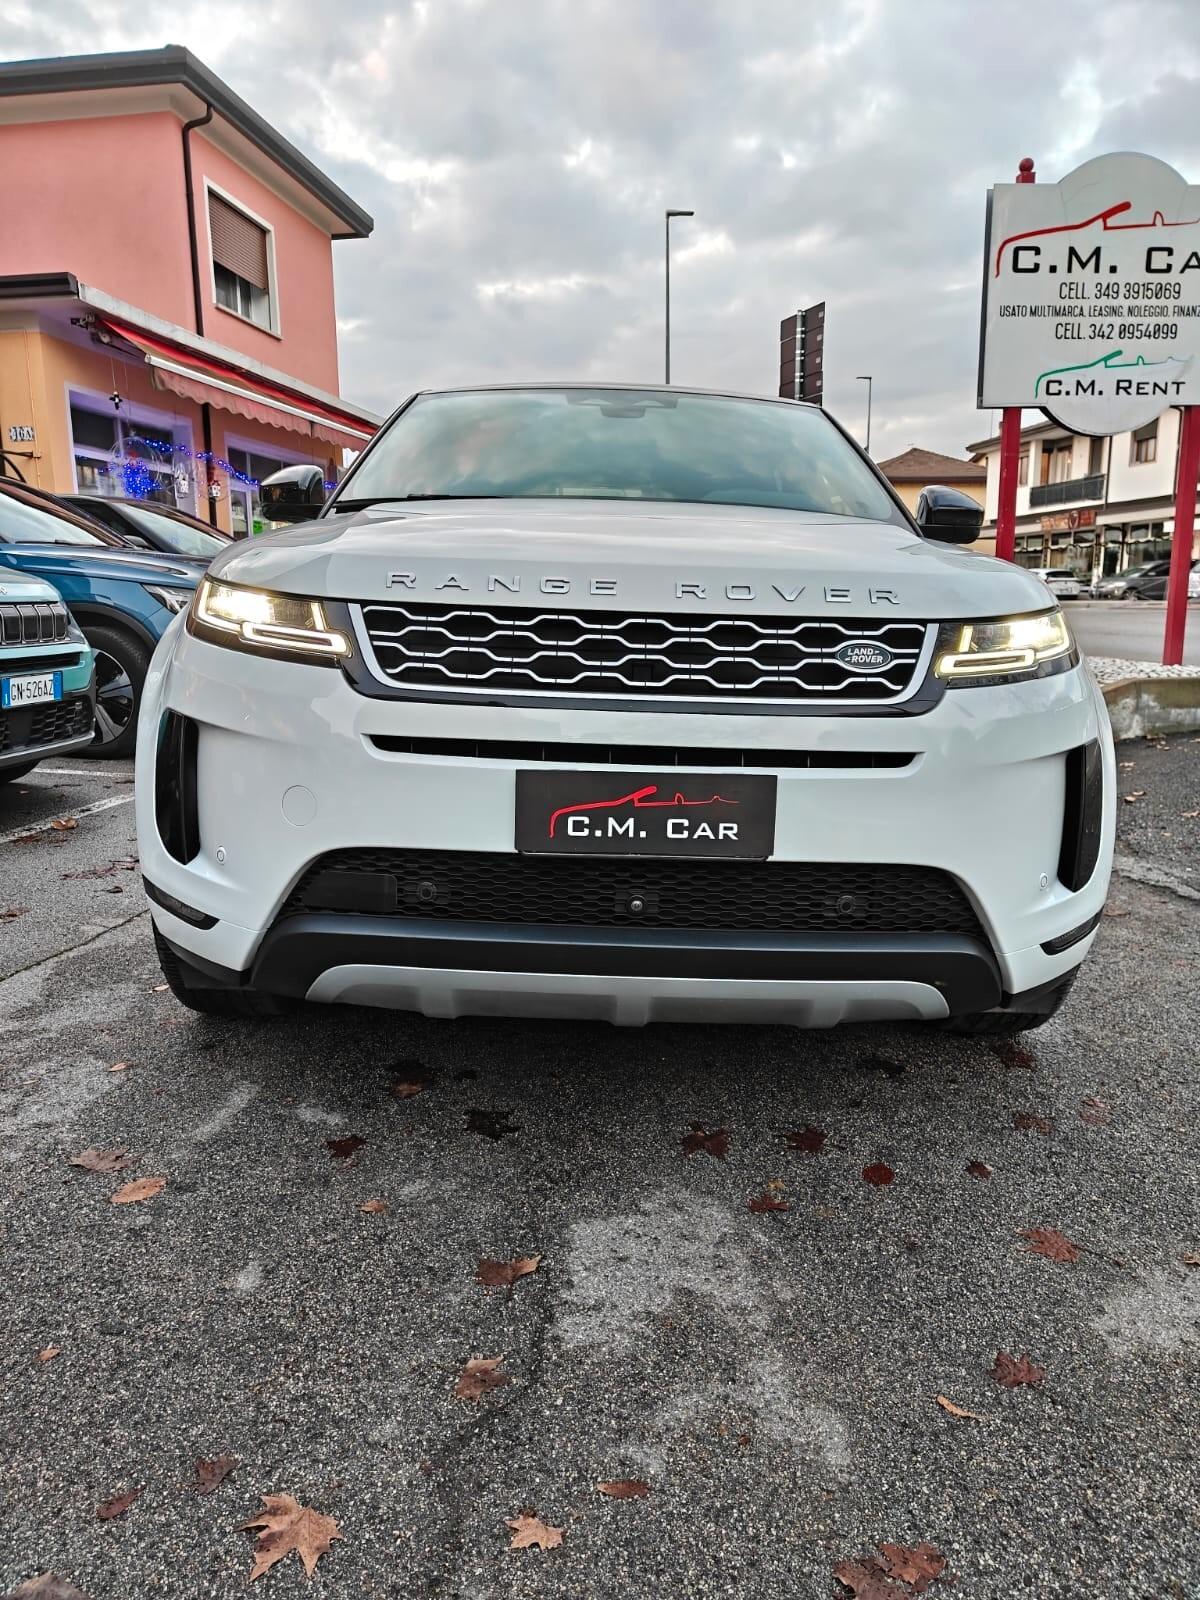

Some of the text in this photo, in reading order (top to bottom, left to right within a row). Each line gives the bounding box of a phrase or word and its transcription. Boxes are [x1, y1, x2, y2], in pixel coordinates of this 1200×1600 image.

[1012, 246, 1117, 273] C.M.
[1059, 282, 1182, 300] CELL. 349 3915069
[999, 304, 1027, 318] USATO
[1055, 322, 1178, 340] CELL. 342 0954099
[1045, 379, 1104, 396] C.M.
[385, 570, 901, 604] RANGE ROVER
[847, 647, 874, 656] LAND
[851, 655, 883, 664] ROVER
[567, 816, 647, 838] C.M.
